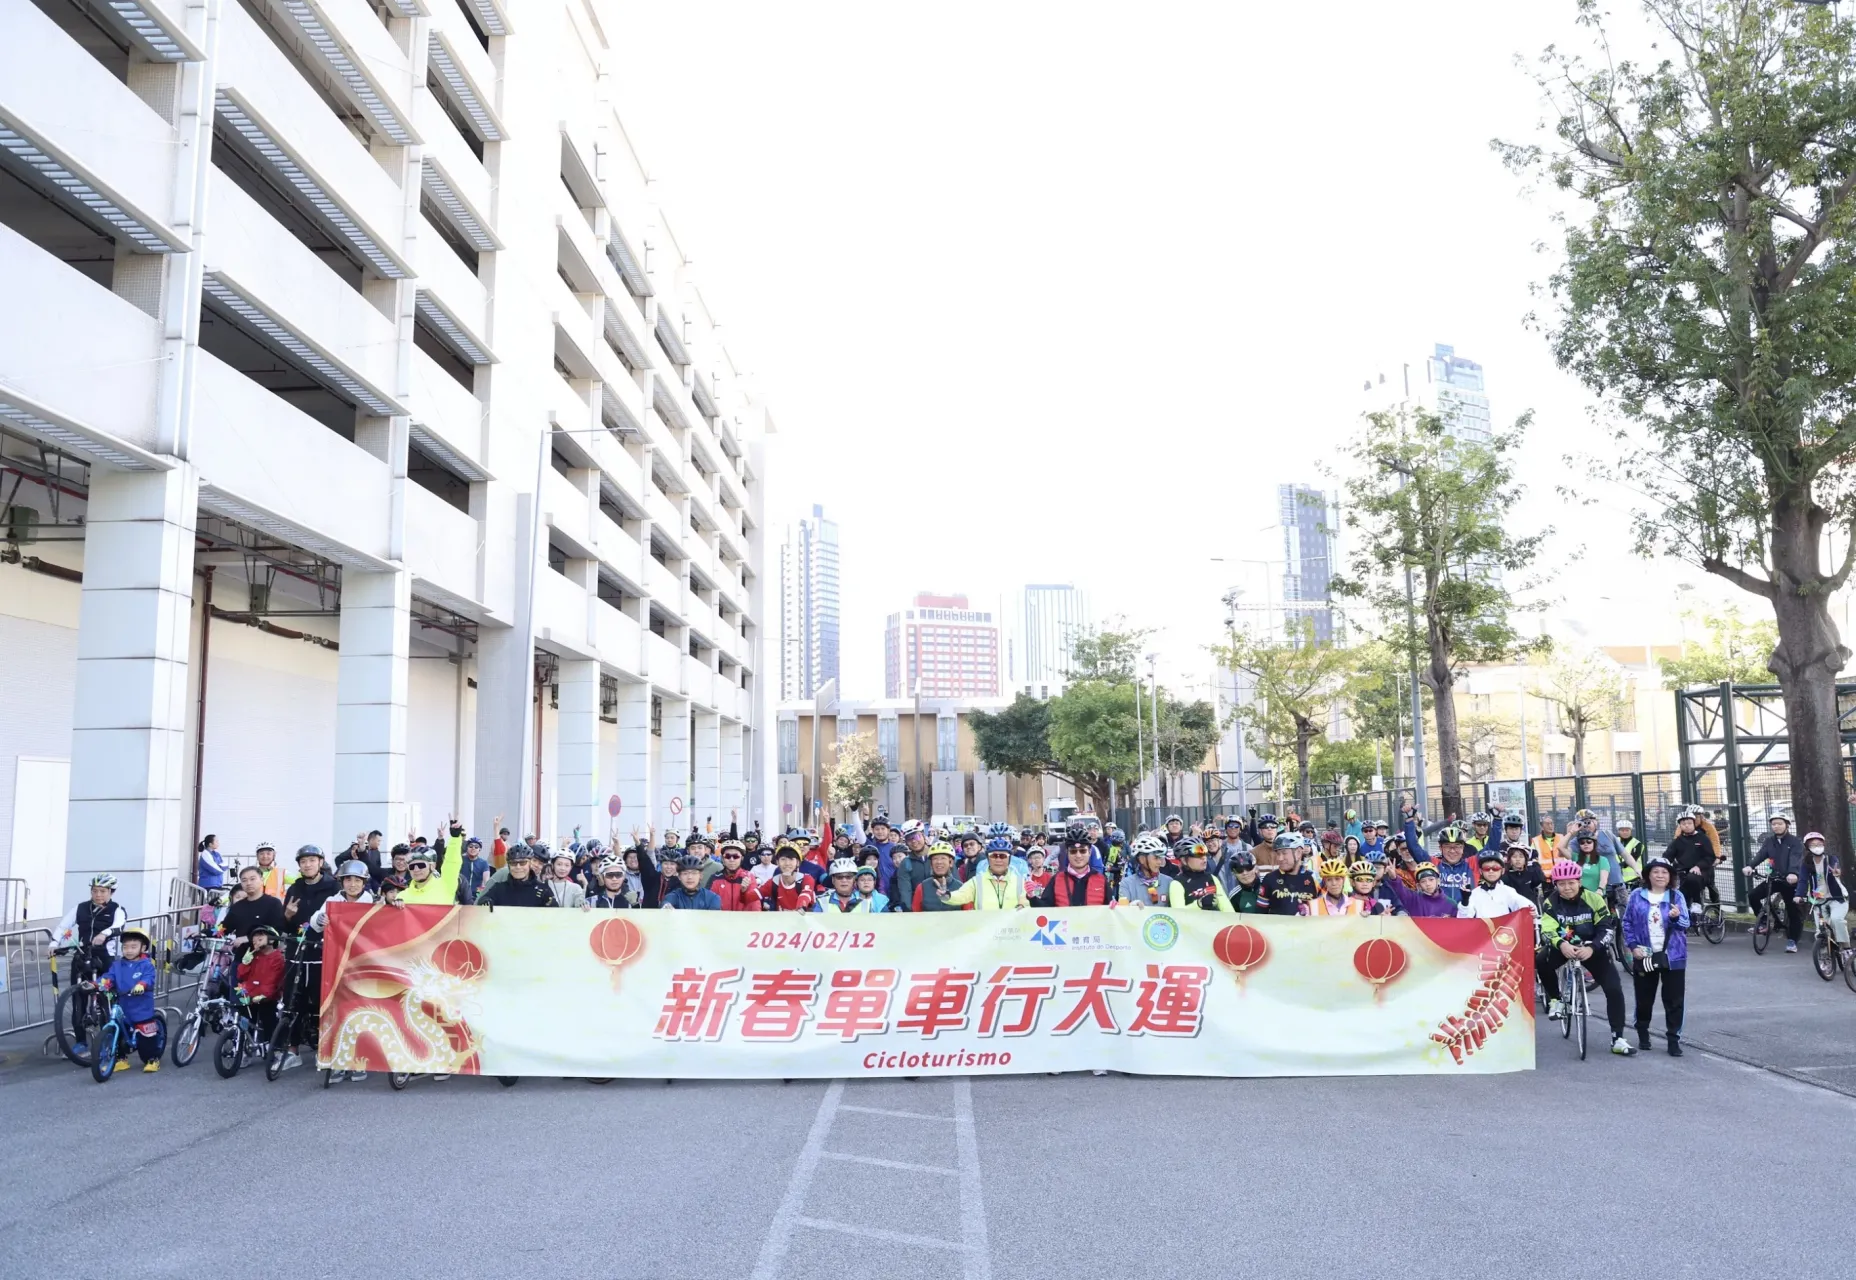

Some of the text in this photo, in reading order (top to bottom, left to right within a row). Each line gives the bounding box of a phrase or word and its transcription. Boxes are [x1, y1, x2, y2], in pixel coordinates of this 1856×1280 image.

[747, 931, 876, 952] 2024/02/12
[653, 961, 1211, 1040] 新春單車行大運
[863, 1048, 1012, 1069] Cicloturismo
